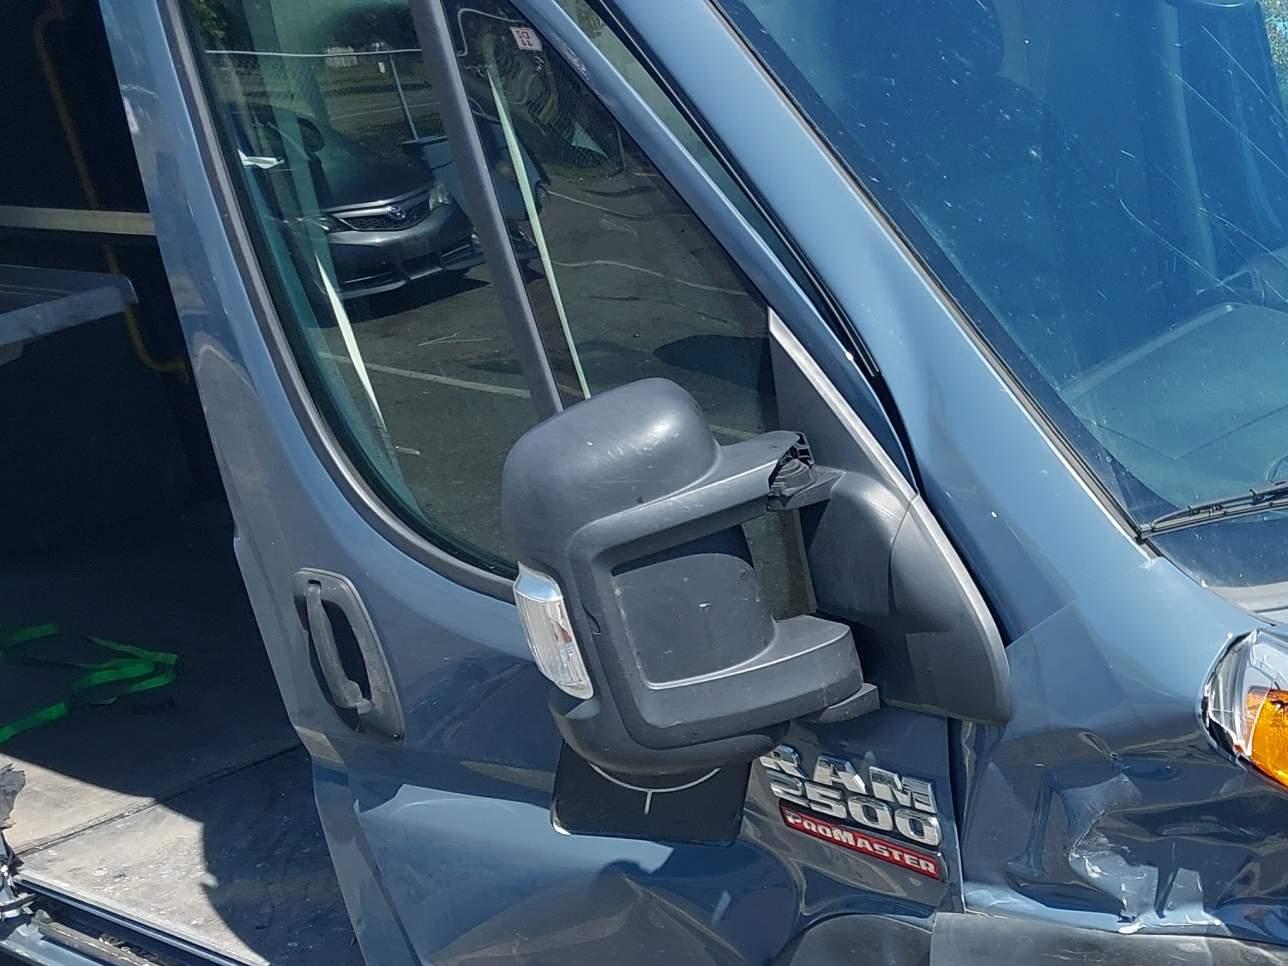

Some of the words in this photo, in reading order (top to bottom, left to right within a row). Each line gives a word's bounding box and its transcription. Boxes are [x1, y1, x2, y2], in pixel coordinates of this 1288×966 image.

[759, 743, 938, 815] RAM
[766, 769, 942, 847] 2500
[785, 813, 938, 876] PROMASTER
